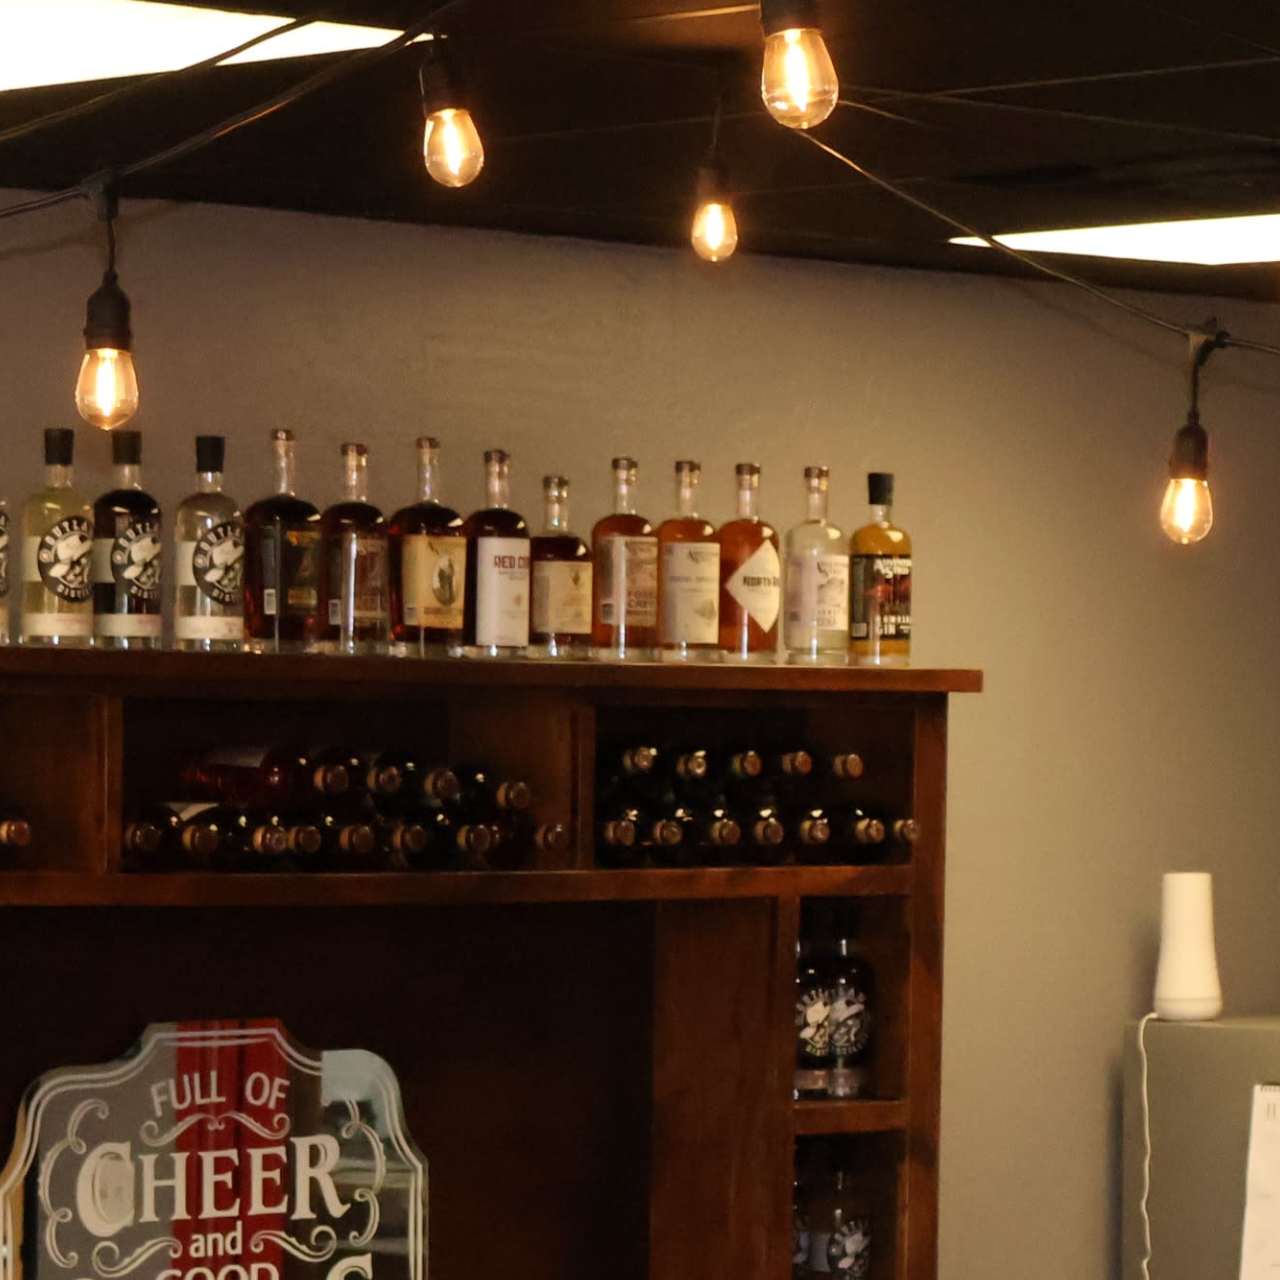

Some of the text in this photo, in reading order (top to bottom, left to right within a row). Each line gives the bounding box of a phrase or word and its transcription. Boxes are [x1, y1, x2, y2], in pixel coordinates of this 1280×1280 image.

[44, 519, 88, 545] OUTLA
[150, 1070, 291, 1117] FULL OF
[76, 1133, 351, 1237] CHEER
[189, 1221, 243, 1258] and
